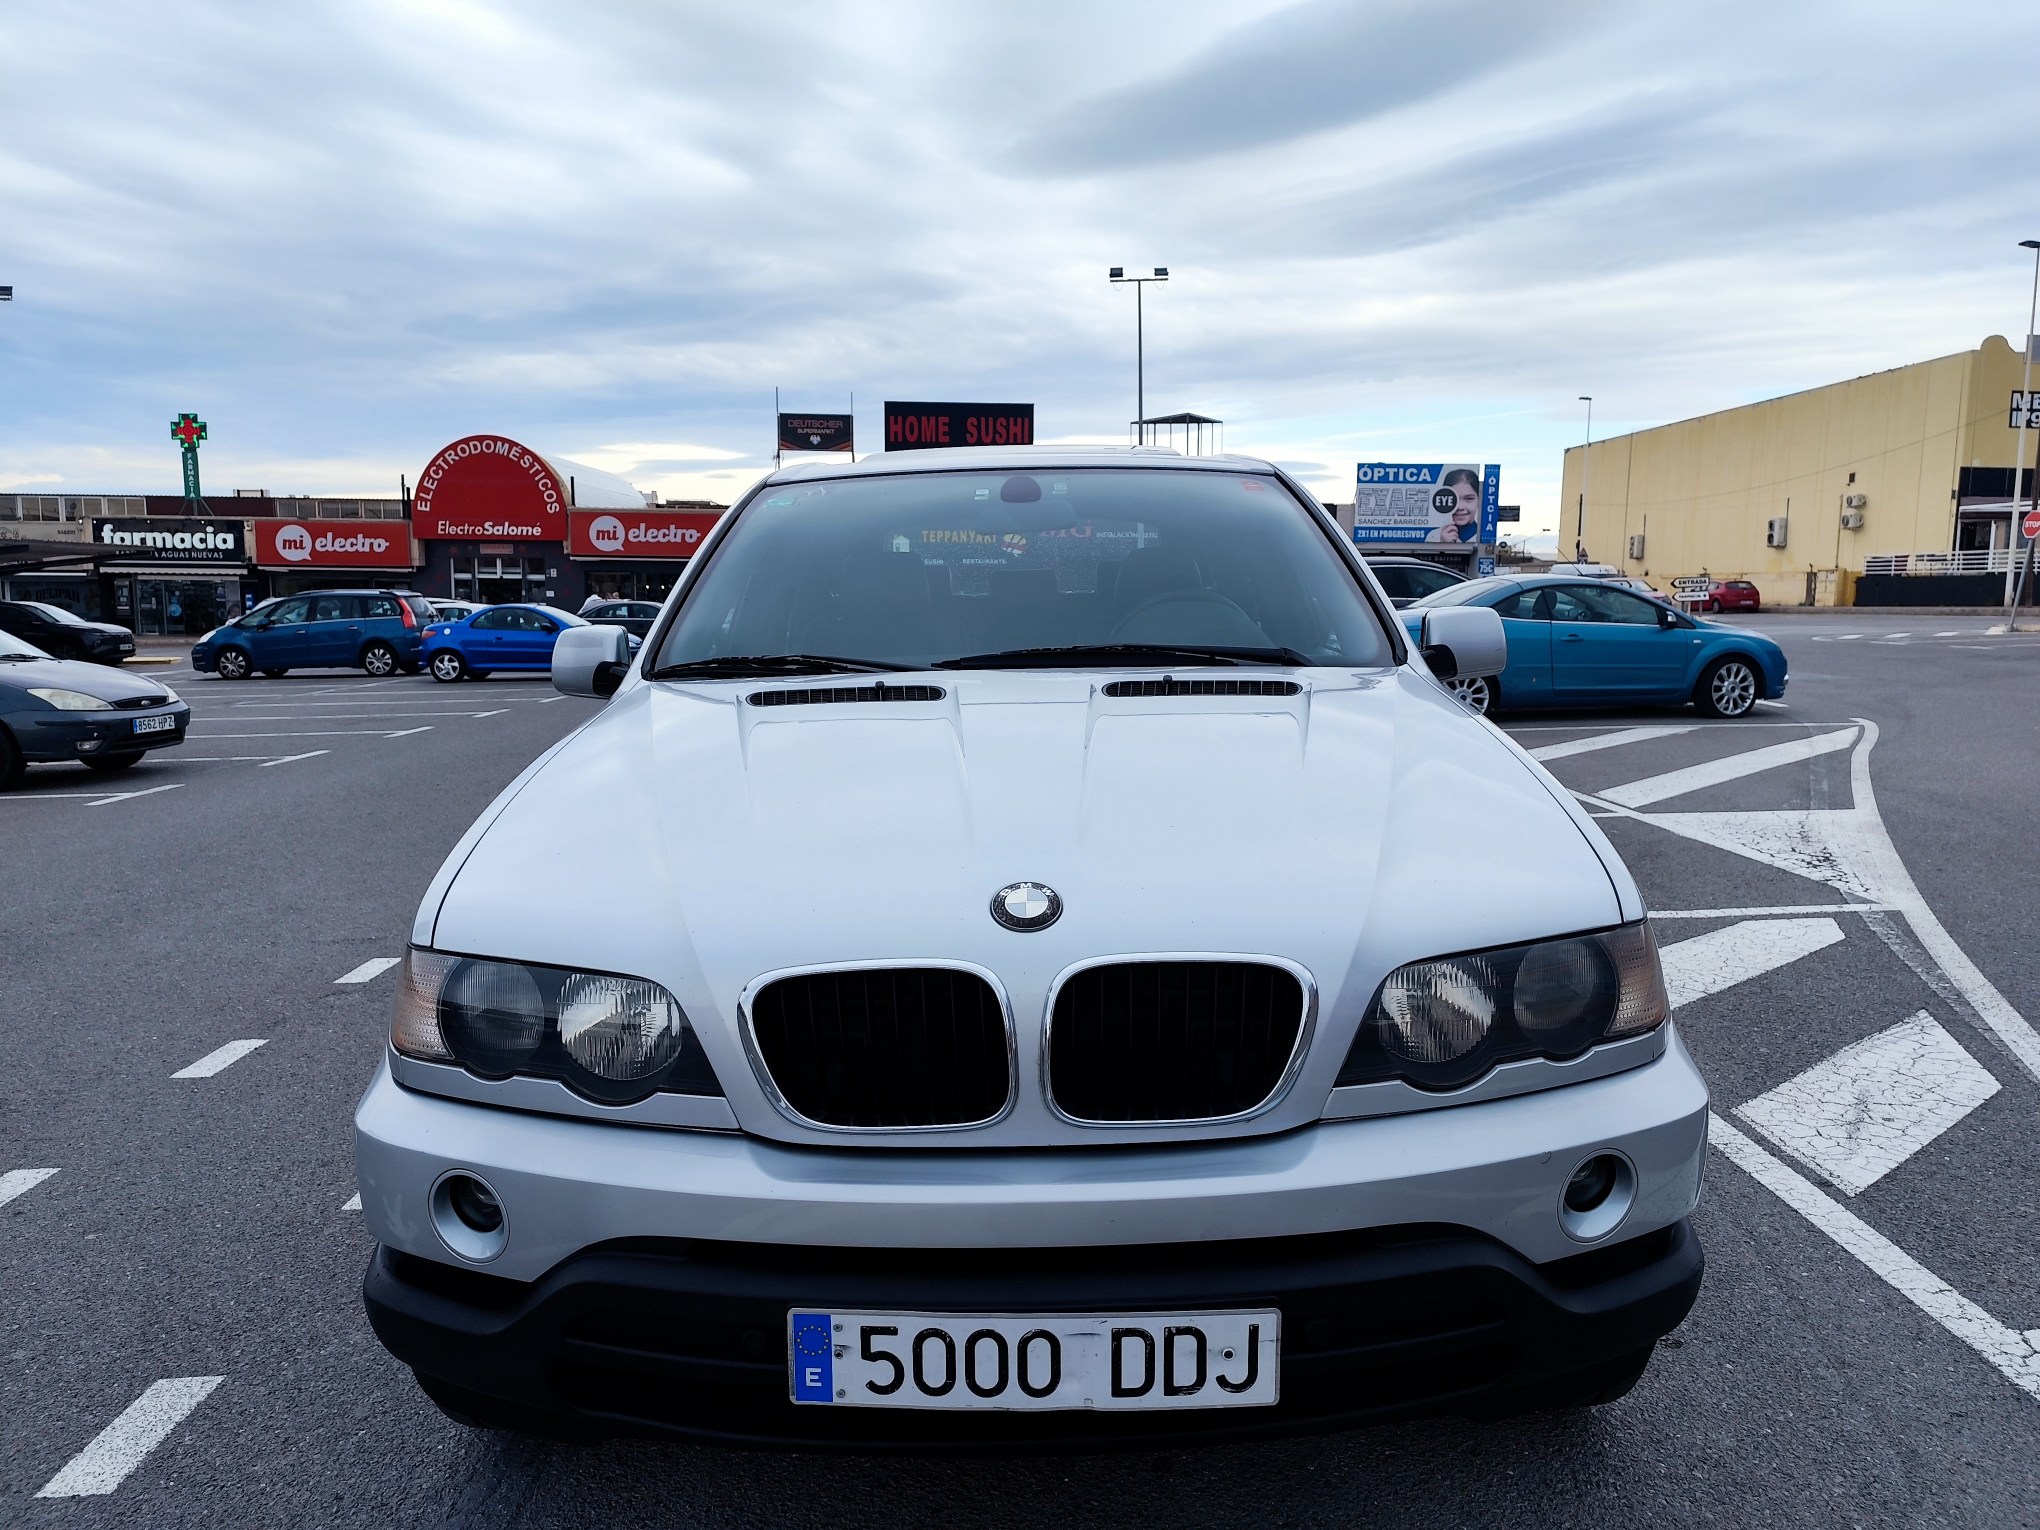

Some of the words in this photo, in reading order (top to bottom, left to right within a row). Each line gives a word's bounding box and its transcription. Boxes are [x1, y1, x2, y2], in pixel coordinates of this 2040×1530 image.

[787, 419, 843, 428] DEUTSCHER
[889, 415, 949, 442] HOME
[966, 417, 1029, 444] SUSHI
[187, 453, 196, 498] FARMACIA
[417, 439, 560, 514] ELECTRODOMÉSTICOS
[1358, 464, 1431, 481] ÓPTICA
[1435, 496, 1453, 507] EYE
[101, 523, 235, 549] farmacia
[437, 520, 542, 536] ElectroSalomé
[596, 525, 619, 541] mi
[627, 522, 701, 543] electro
[1370, 529, 1379, 537] EN
[1380, 530, 1425, 538] PROGRESIVOS
[282, 535, 306, 550] mi
[315, 531, 390, 553] electro
[191, 551, 224, 559] NUEVAS
[138, 718, 157, 732] 8562
[158, 716, 174, 730] HPZ
[859, 1325, 1062, 1398] 5000
[1111, 1323, 1260, 1398] DDJ
[805, 1367, 822, 1387] E
